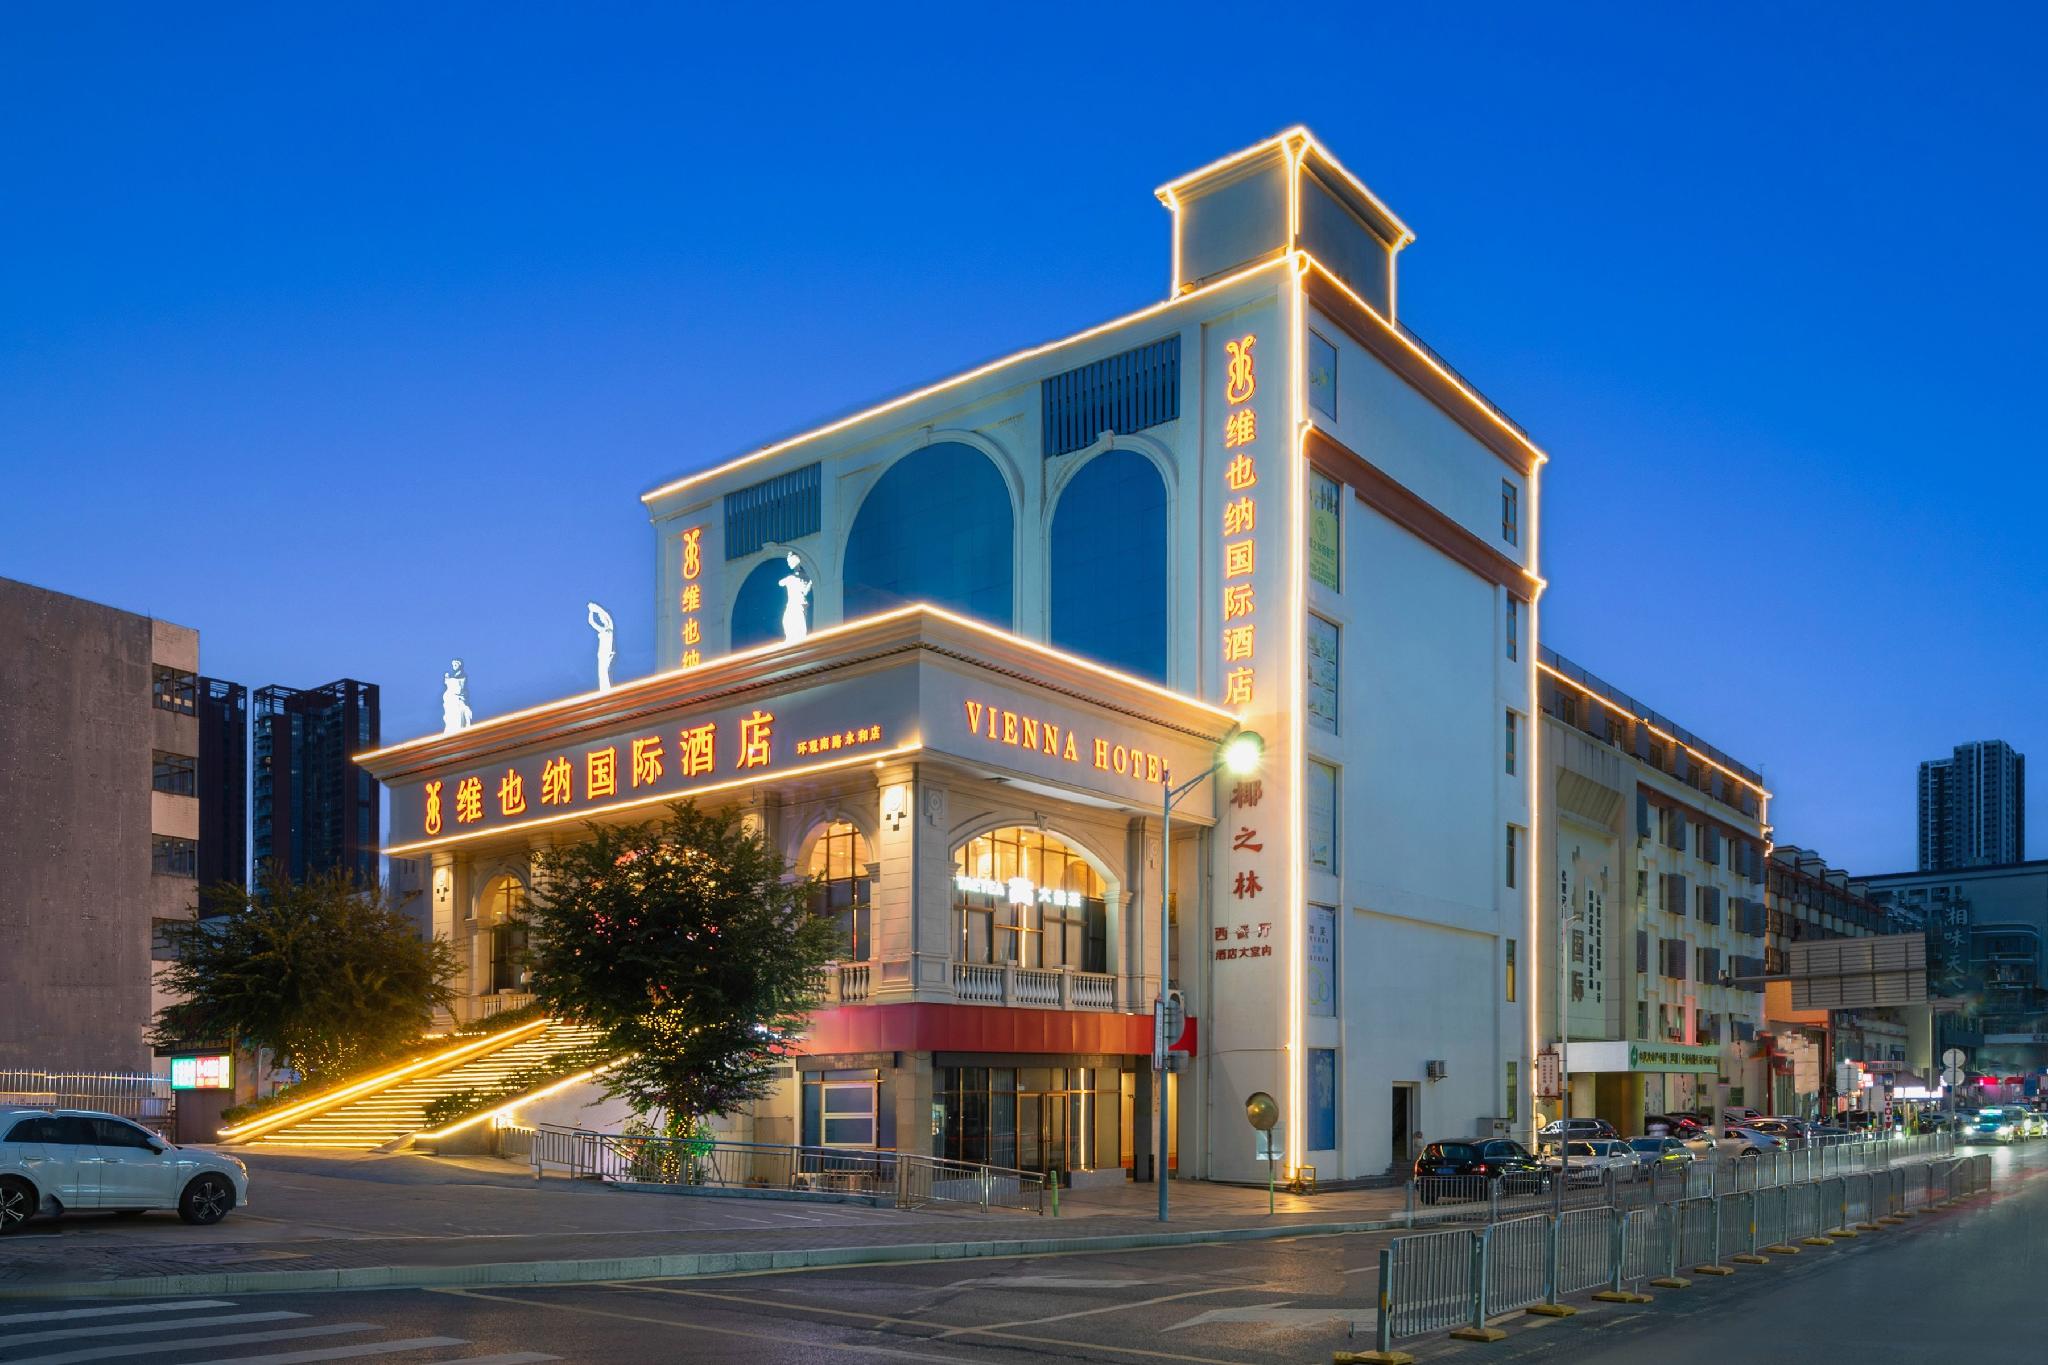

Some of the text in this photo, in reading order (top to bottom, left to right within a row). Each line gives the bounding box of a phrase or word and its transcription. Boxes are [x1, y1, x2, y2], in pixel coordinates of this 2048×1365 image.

[1224, 408, 1257, 704] 维也纳国际酒店
[456, 710, 775, 823] 维也纳国际酒店
[966, 701, 1173, 786] VIENNA HOTEL
[1215, 945, 1272, 961] 酒店大堂内
